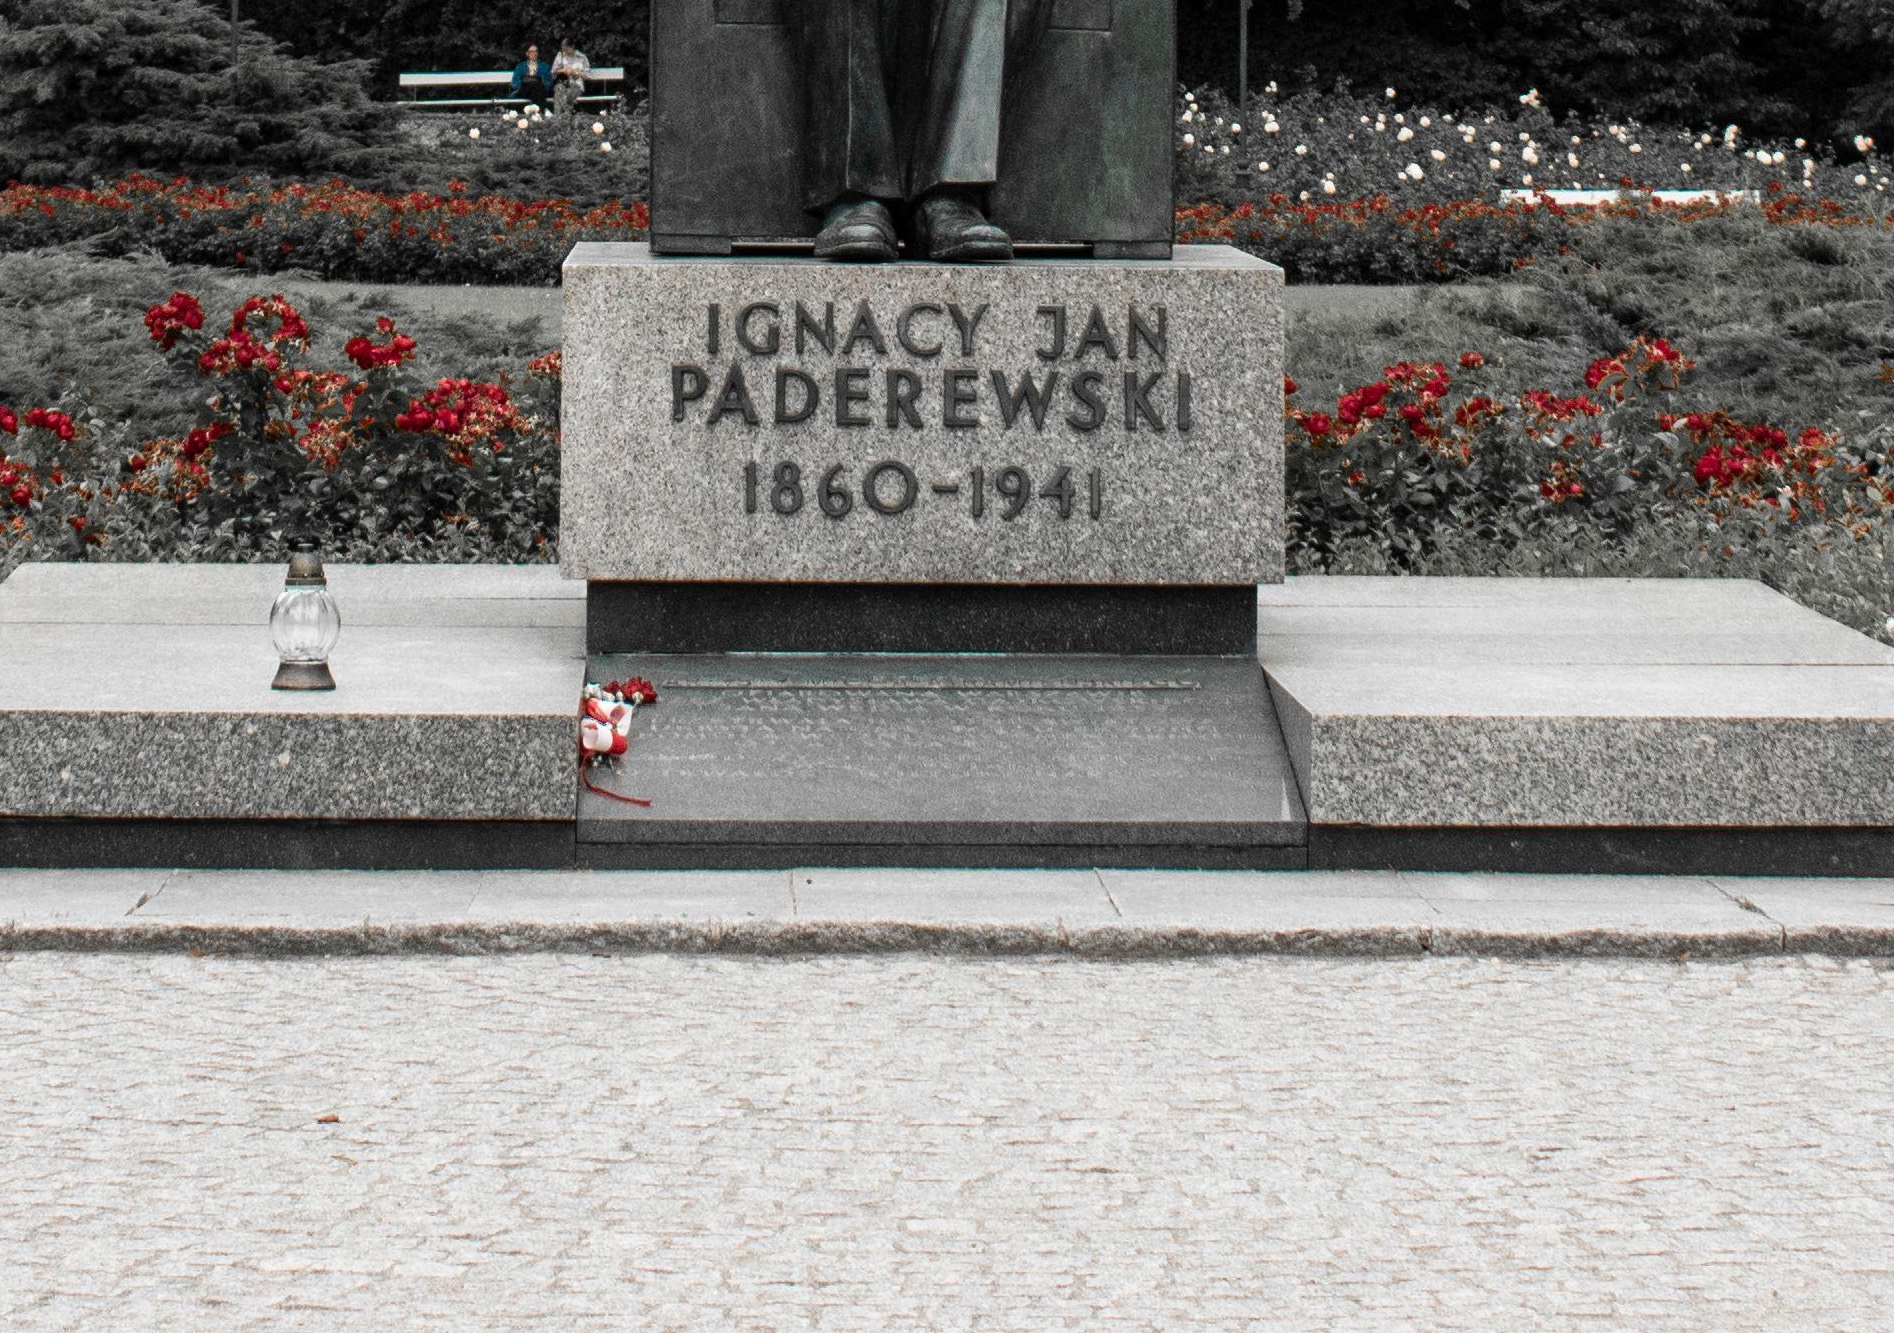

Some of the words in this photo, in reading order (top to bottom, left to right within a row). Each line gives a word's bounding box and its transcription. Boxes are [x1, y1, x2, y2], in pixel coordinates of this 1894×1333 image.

[706, 301, 991, 357] IGNACY
[1036, 305, 1169, 360] JAN
[671, 365, 1191, 431] PADEREWSKI
[743, 459, 1103, 521] 1860-1941
